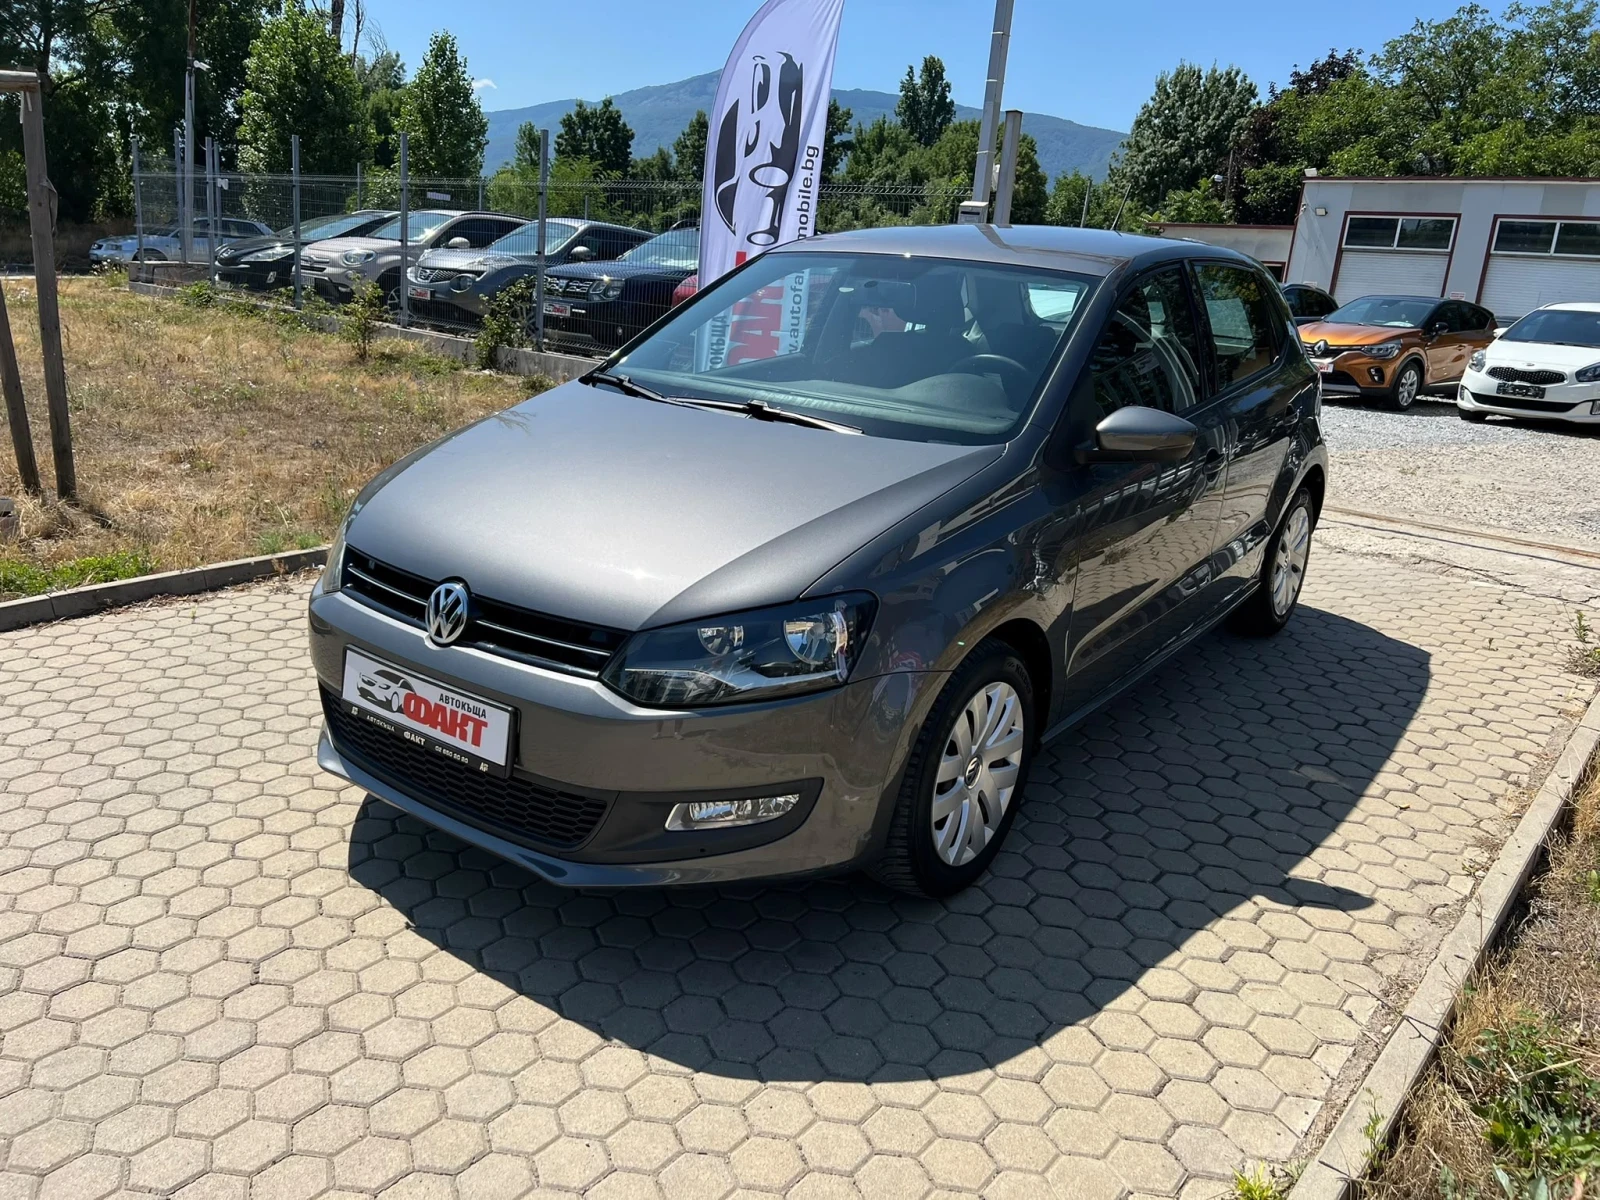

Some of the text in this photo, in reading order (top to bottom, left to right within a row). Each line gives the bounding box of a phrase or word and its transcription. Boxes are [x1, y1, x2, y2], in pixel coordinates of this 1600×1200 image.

[439, 693, 487, 719] АВТОКЪЩА
[403, 692, 488, 747] ФАКТ
[403, 731, 426, 746] ФАКТ
